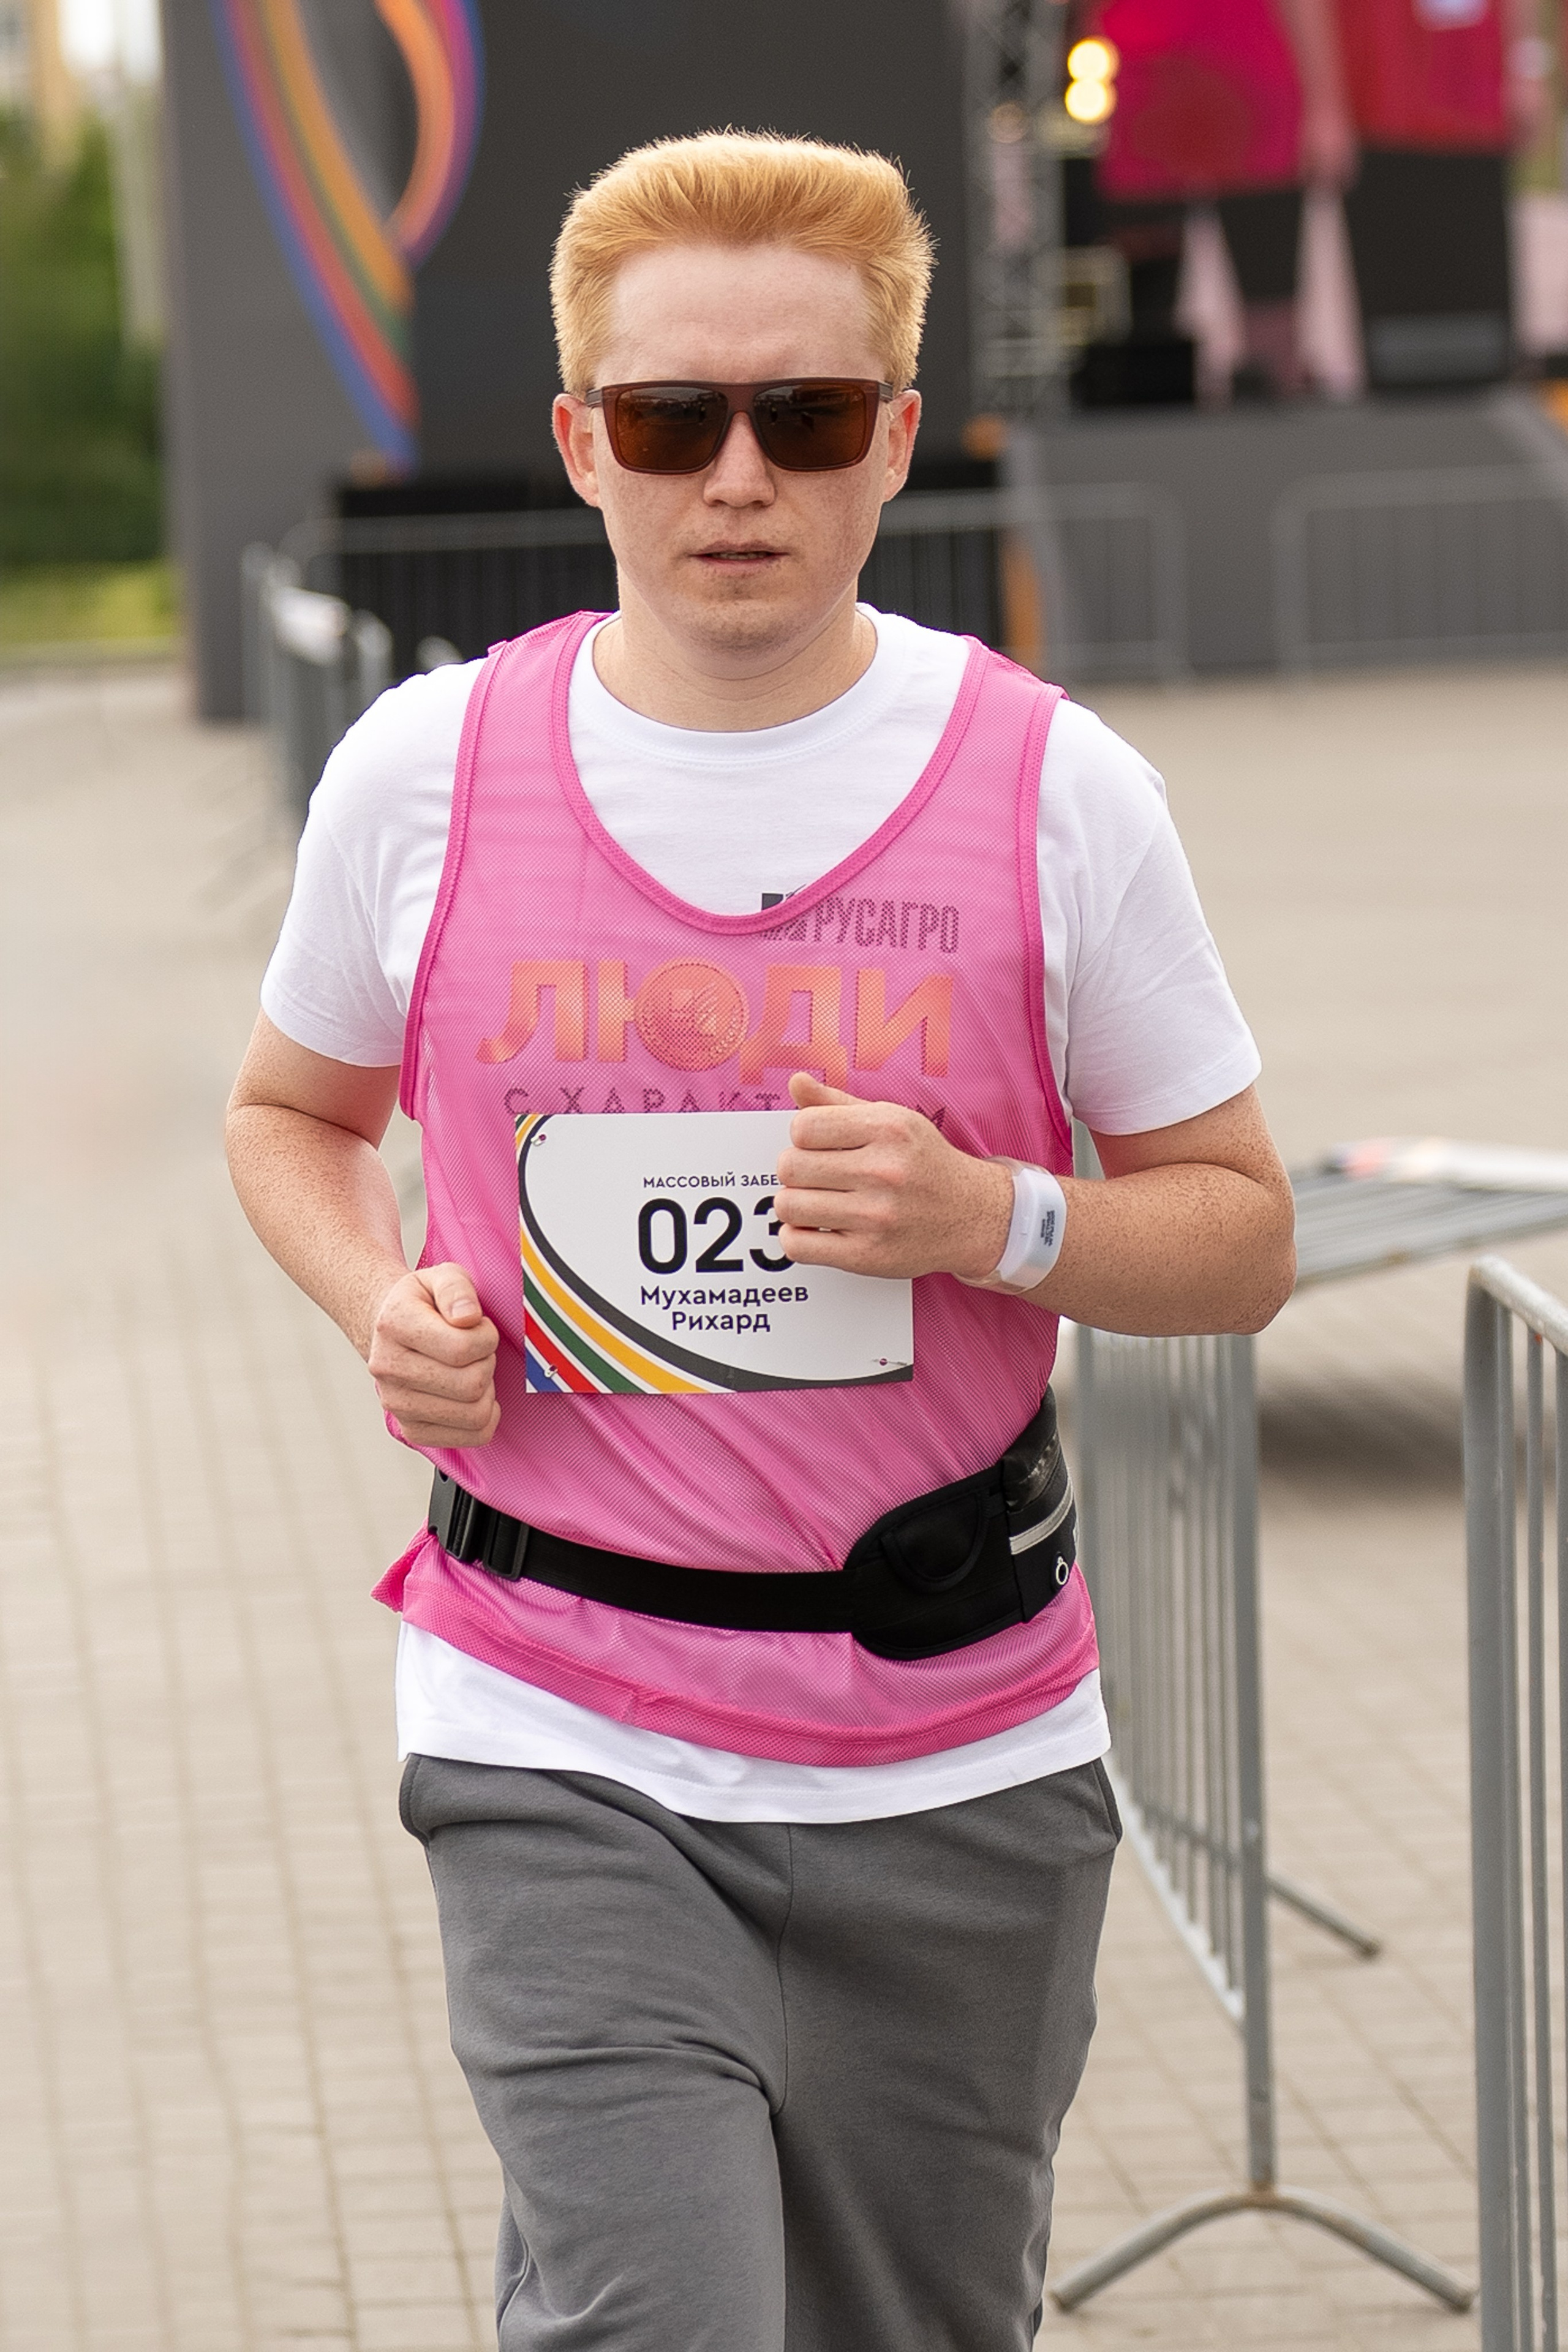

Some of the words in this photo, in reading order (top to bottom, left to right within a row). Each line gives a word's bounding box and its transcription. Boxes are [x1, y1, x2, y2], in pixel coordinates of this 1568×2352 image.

[813, 895, 959, 954] РУСАГРО
[476, 957, 954, 1090] ЛЮДИ
[643, 1171, 736, 1188] МАССОВЫЙ
[741, 1174, 785, 1187] ЗАБЕ
[638, 1196, 796, 1275] 023
[640, 1285, 809, 1310] Мухамадеев
[671, 1311, 771, 1335] Рихард
